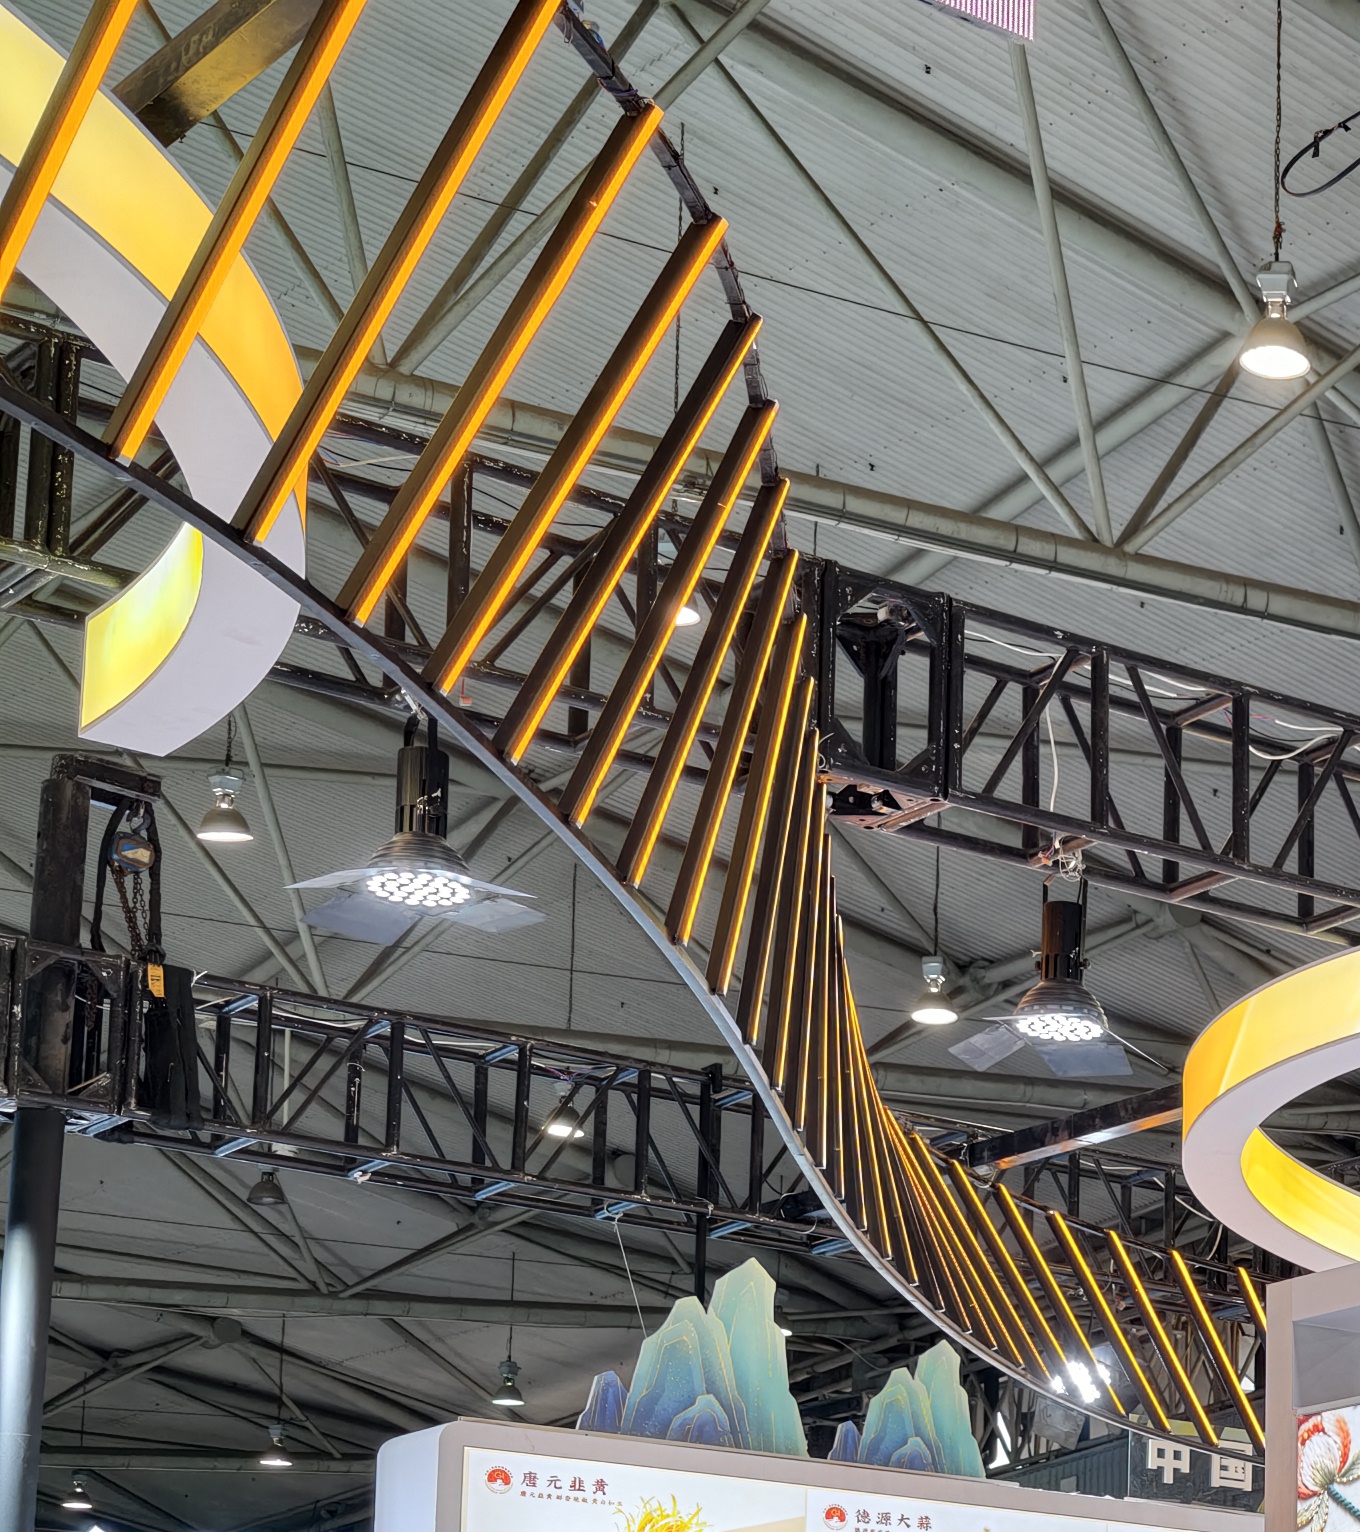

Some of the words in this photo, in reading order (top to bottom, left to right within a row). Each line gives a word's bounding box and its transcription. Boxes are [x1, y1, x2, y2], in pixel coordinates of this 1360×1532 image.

[520, 1471, 609, 1496] 唐元韭黄
[855, 1509, 932, 1531] 德源大蒜
